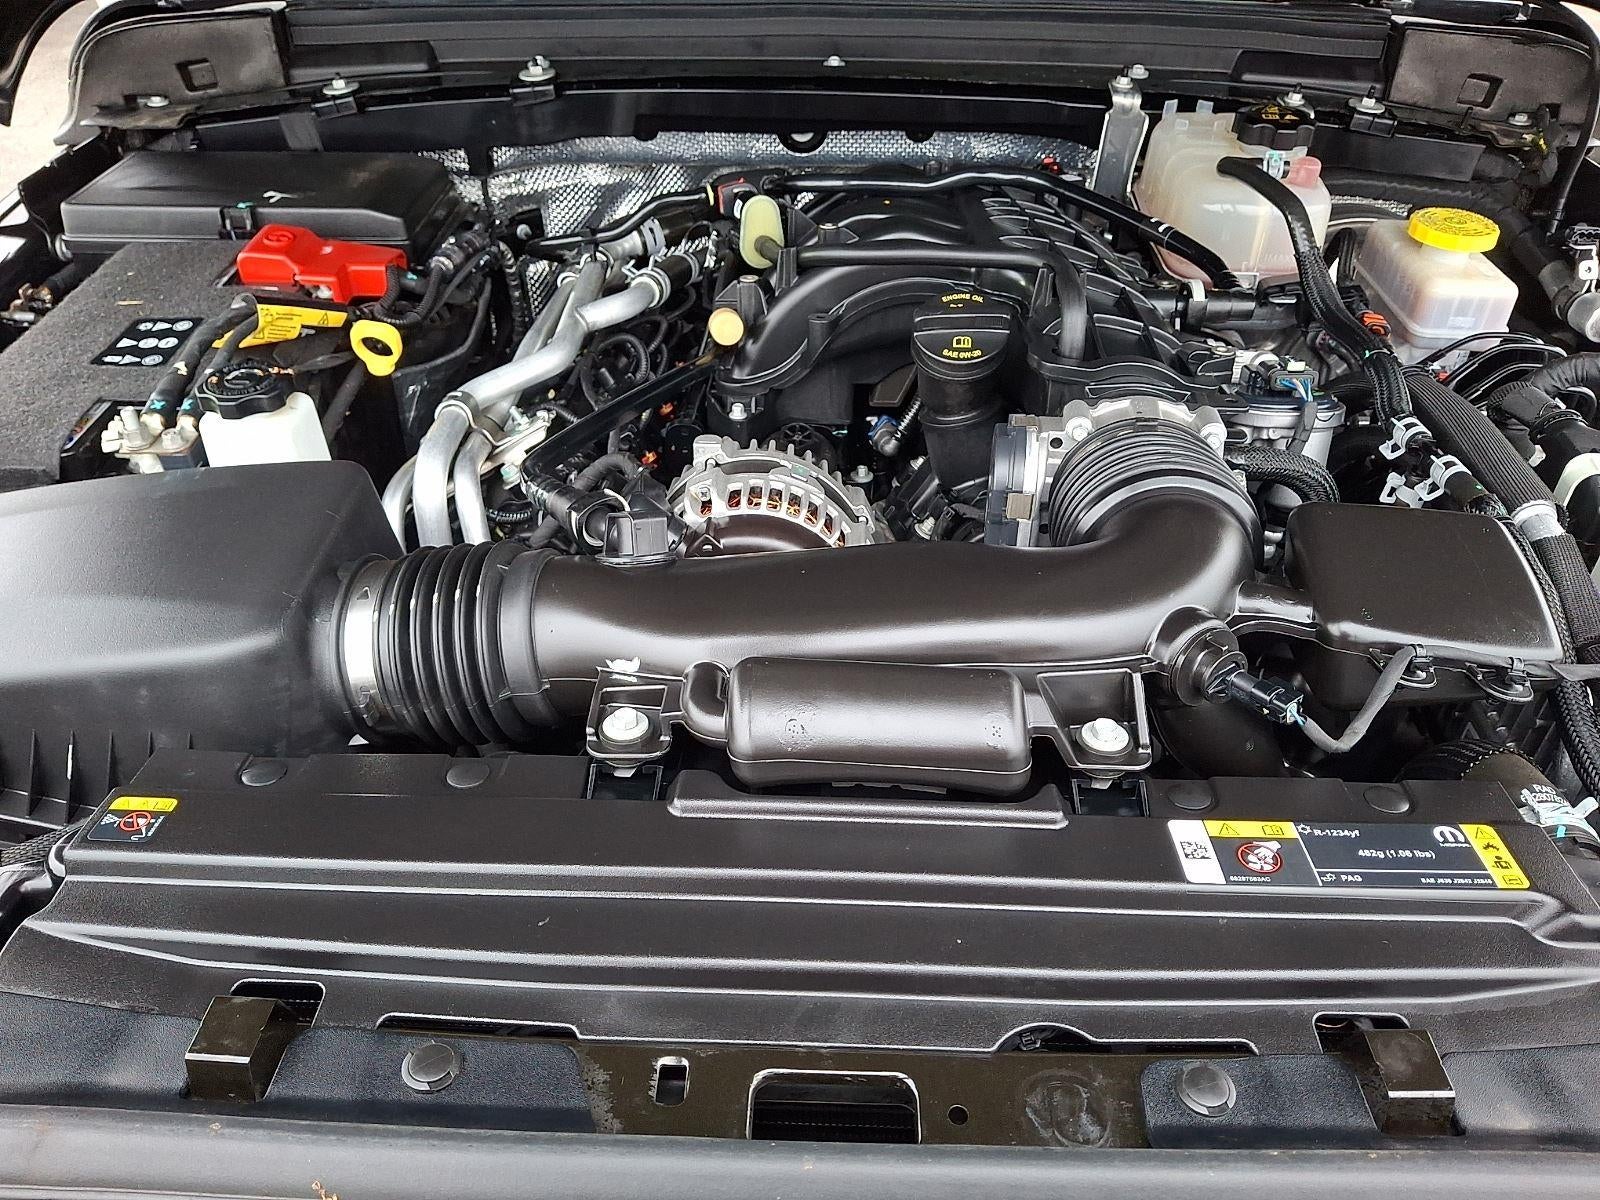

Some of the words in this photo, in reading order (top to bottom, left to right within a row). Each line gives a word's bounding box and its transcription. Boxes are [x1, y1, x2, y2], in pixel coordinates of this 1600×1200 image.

[942, 293, 971, 302] ENGINE
[972, 294, 984, 303] OIL
[942, 348, 959, 358] SAE
[1358, 849, 1385, 859] 482g
[1413, 850, 1436, 860] lbs)
[1340, 874, 1363, 882] PAG
